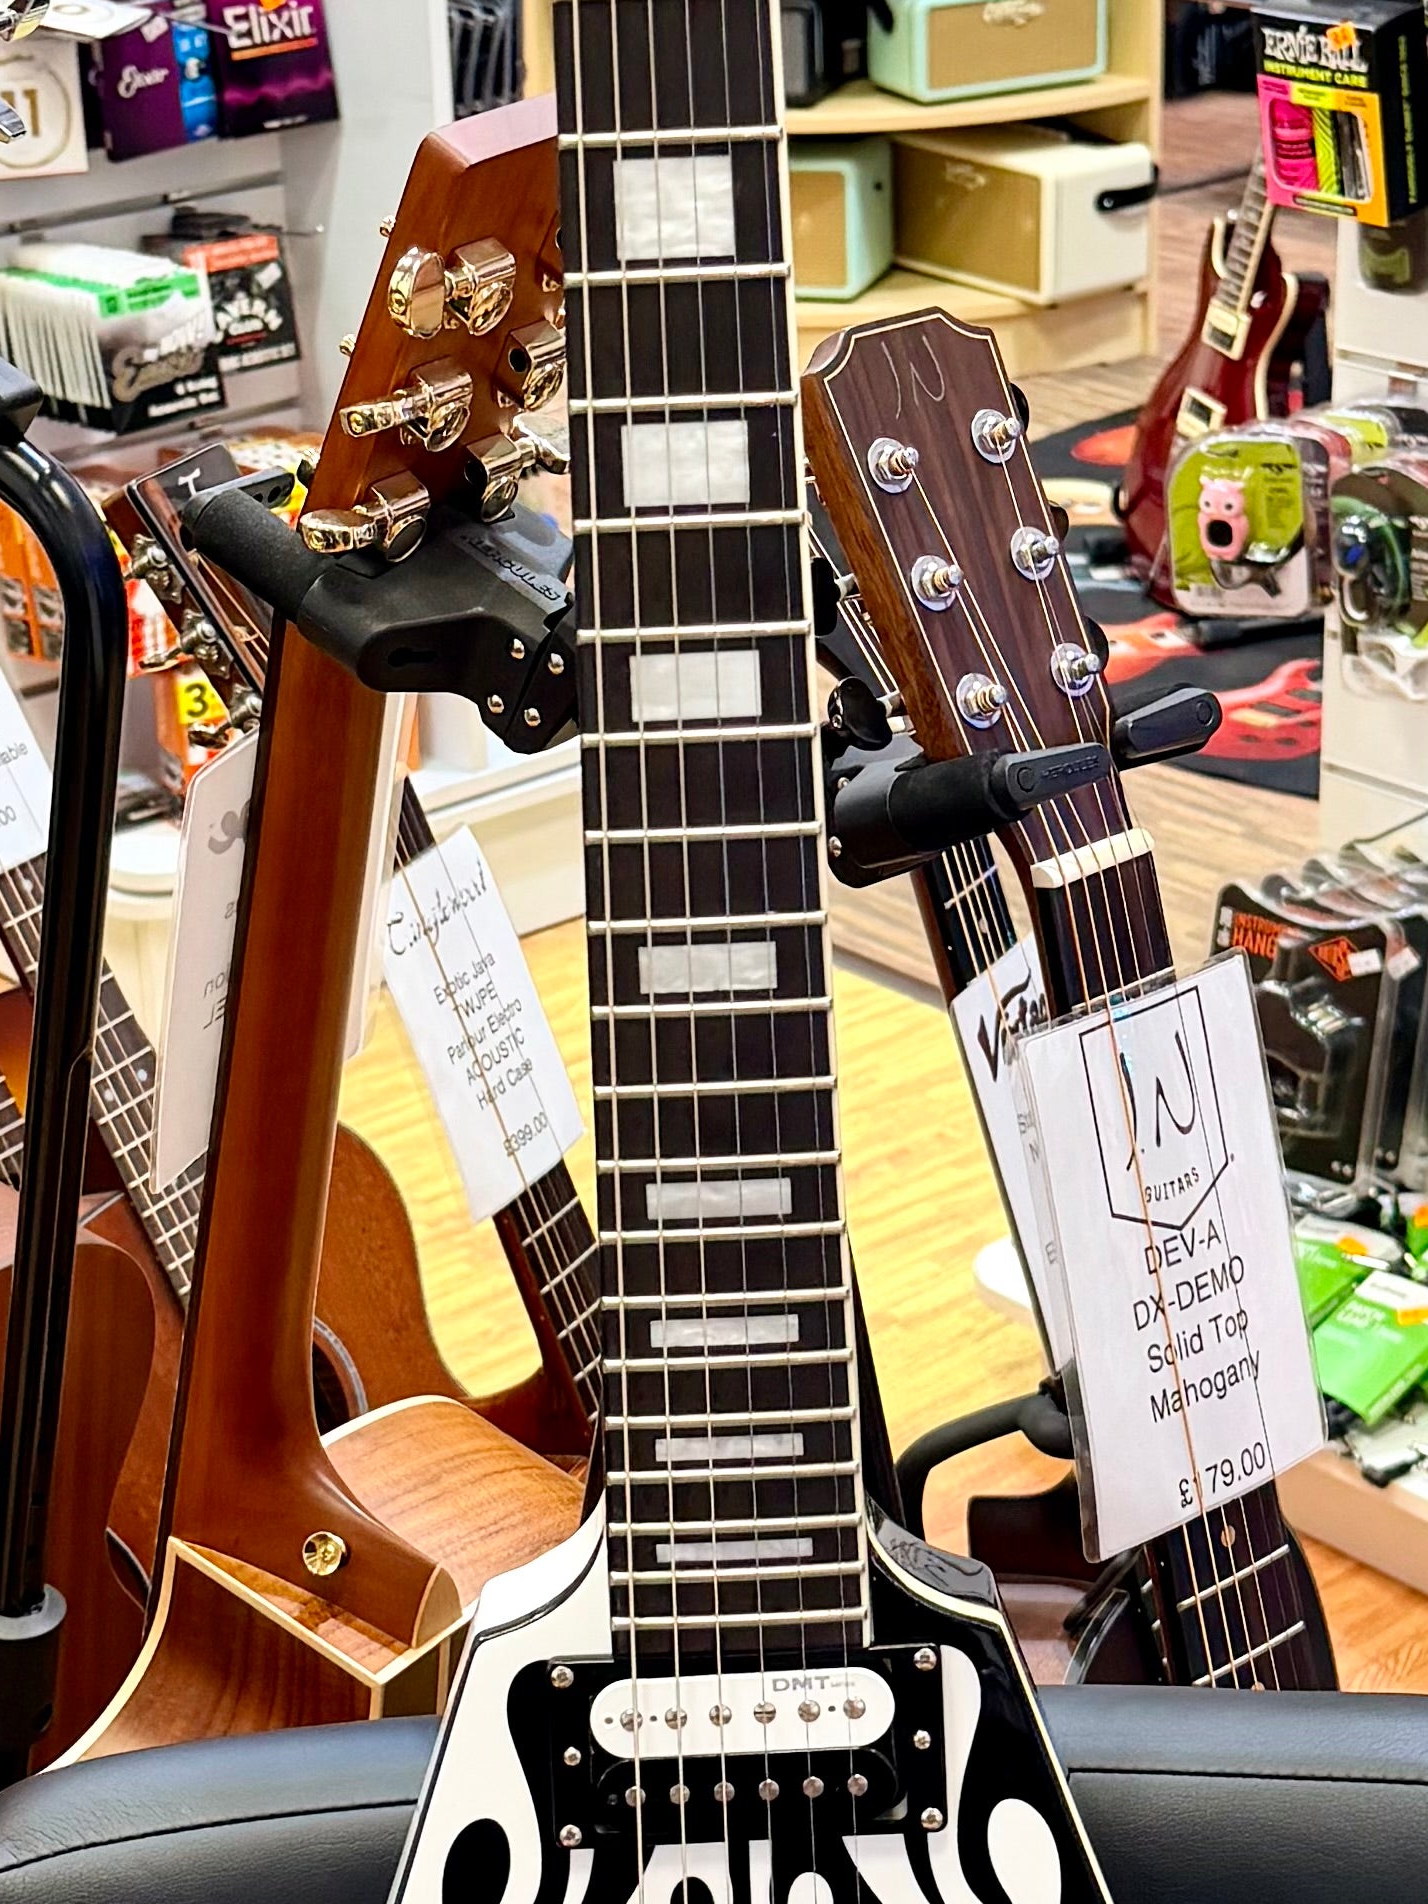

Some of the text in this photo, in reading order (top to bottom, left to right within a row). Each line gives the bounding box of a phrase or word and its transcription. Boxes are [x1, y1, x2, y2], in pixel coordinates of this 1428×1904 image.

[222, 0, 316, 50] Elixir
[1261, 22, 1318, 65] ERNIE
[1263, 59, 1370, 89] INSTRUMENT CARE
[1232, 928, 1279, 958] HANG
[1233, 913, 1290, 938] INSTRUM
[432, 951, 497, 1007] Exotic Java
[446, 996, 524, 1066] Parlour Electro
[465, 1026, 527, 1087] ACOUSTIC
[476, 1056, 534, 1111] Hard Case
[1144, 1166, 1201, 1205] GUITARS
[1144, 1218, 1224, 1277] DEV-A
[1132, 1253, 1247, 1333] DX-DEMO
[1147, 1306, 1250, 1375] Solid Top
[1150, 1349, 1262, 1425] Mahogany
[771, 1674, 831, 1695] DMT
